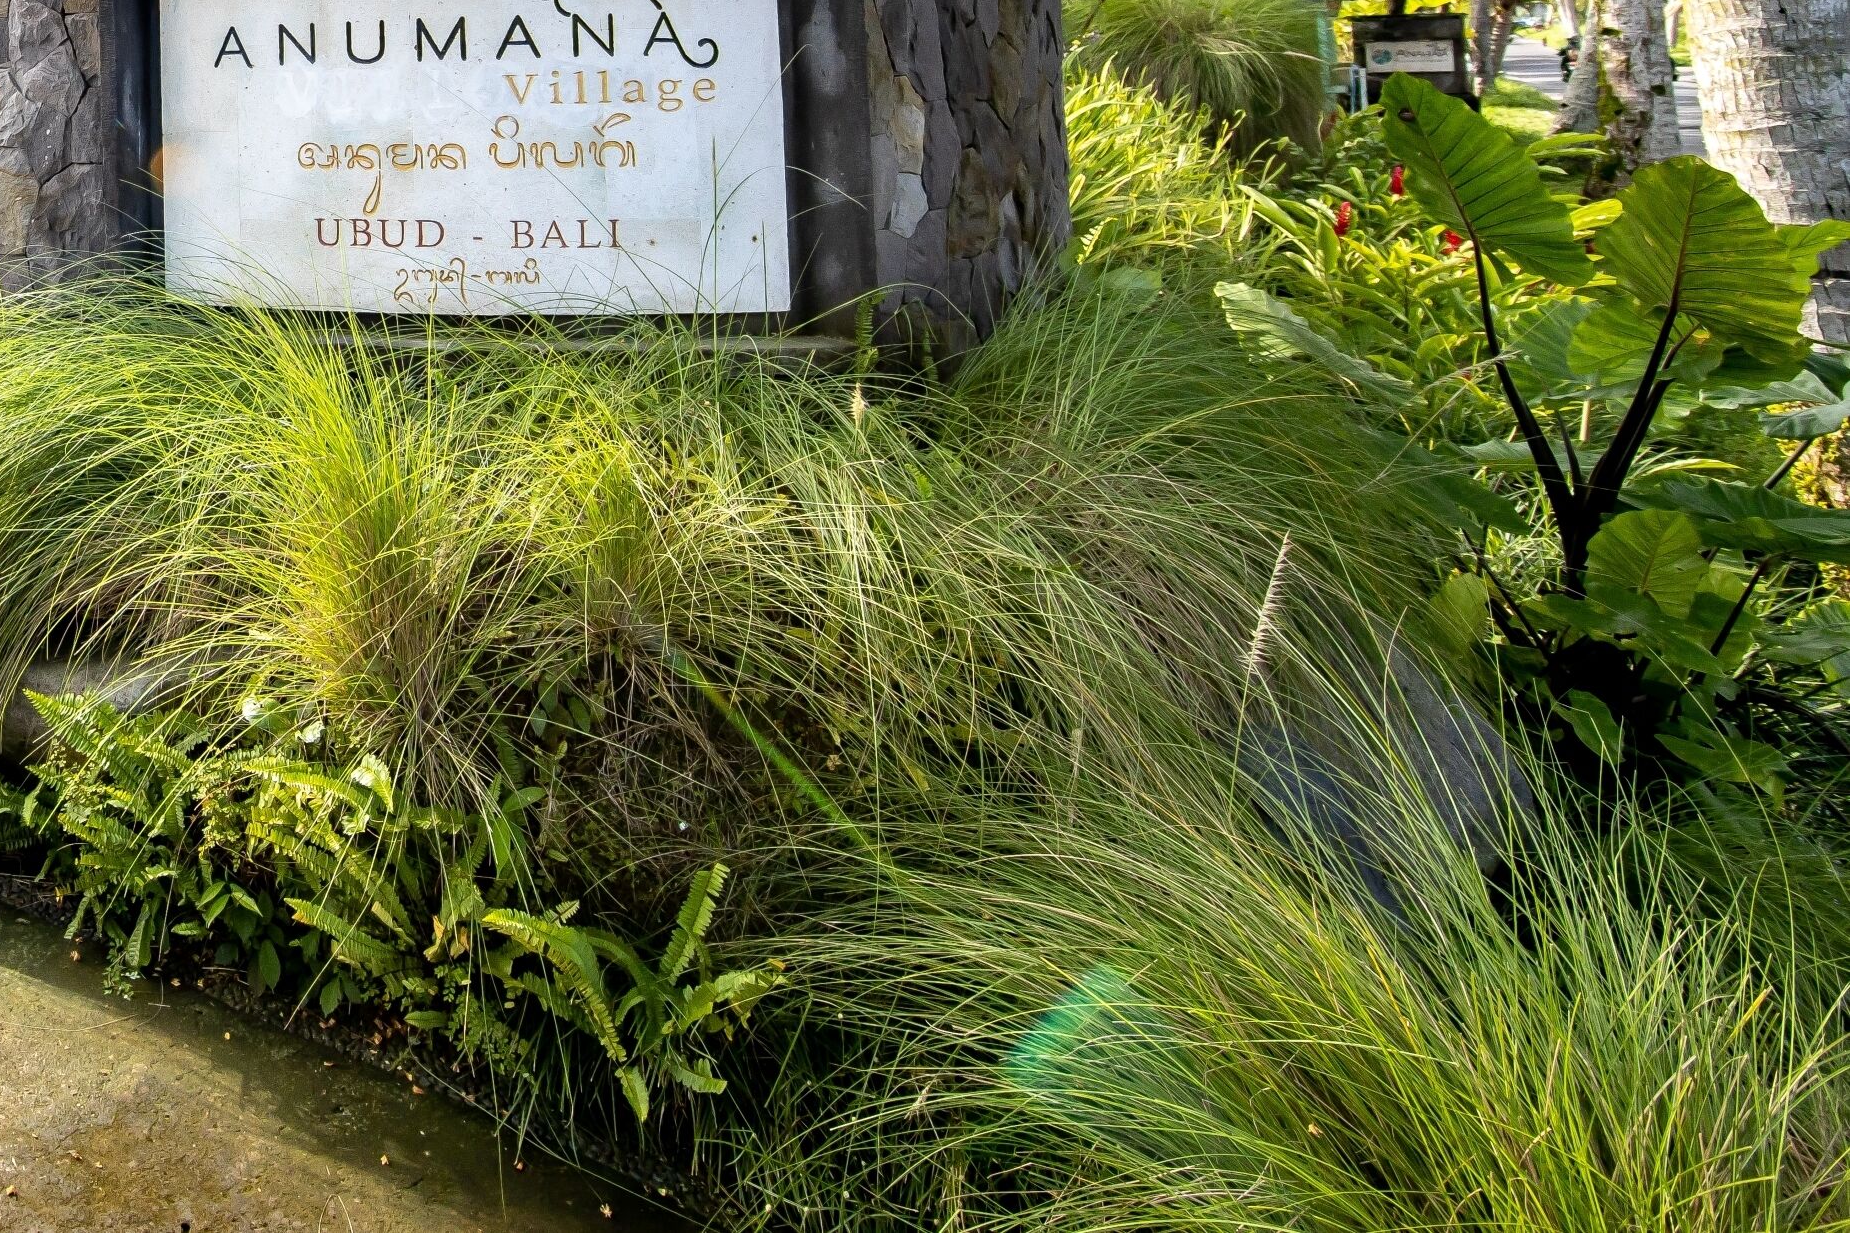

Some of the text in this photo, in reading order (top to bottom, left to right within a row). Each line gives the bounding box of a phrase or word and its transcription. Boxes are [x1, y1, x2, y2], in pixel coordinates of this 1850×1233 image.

[214, 11, 719, 69] ANUMANA
[502, 70, 717, 112] Village
[314, 217, 446, 248] UBUD
[510, 218, 622, 248] BALI
